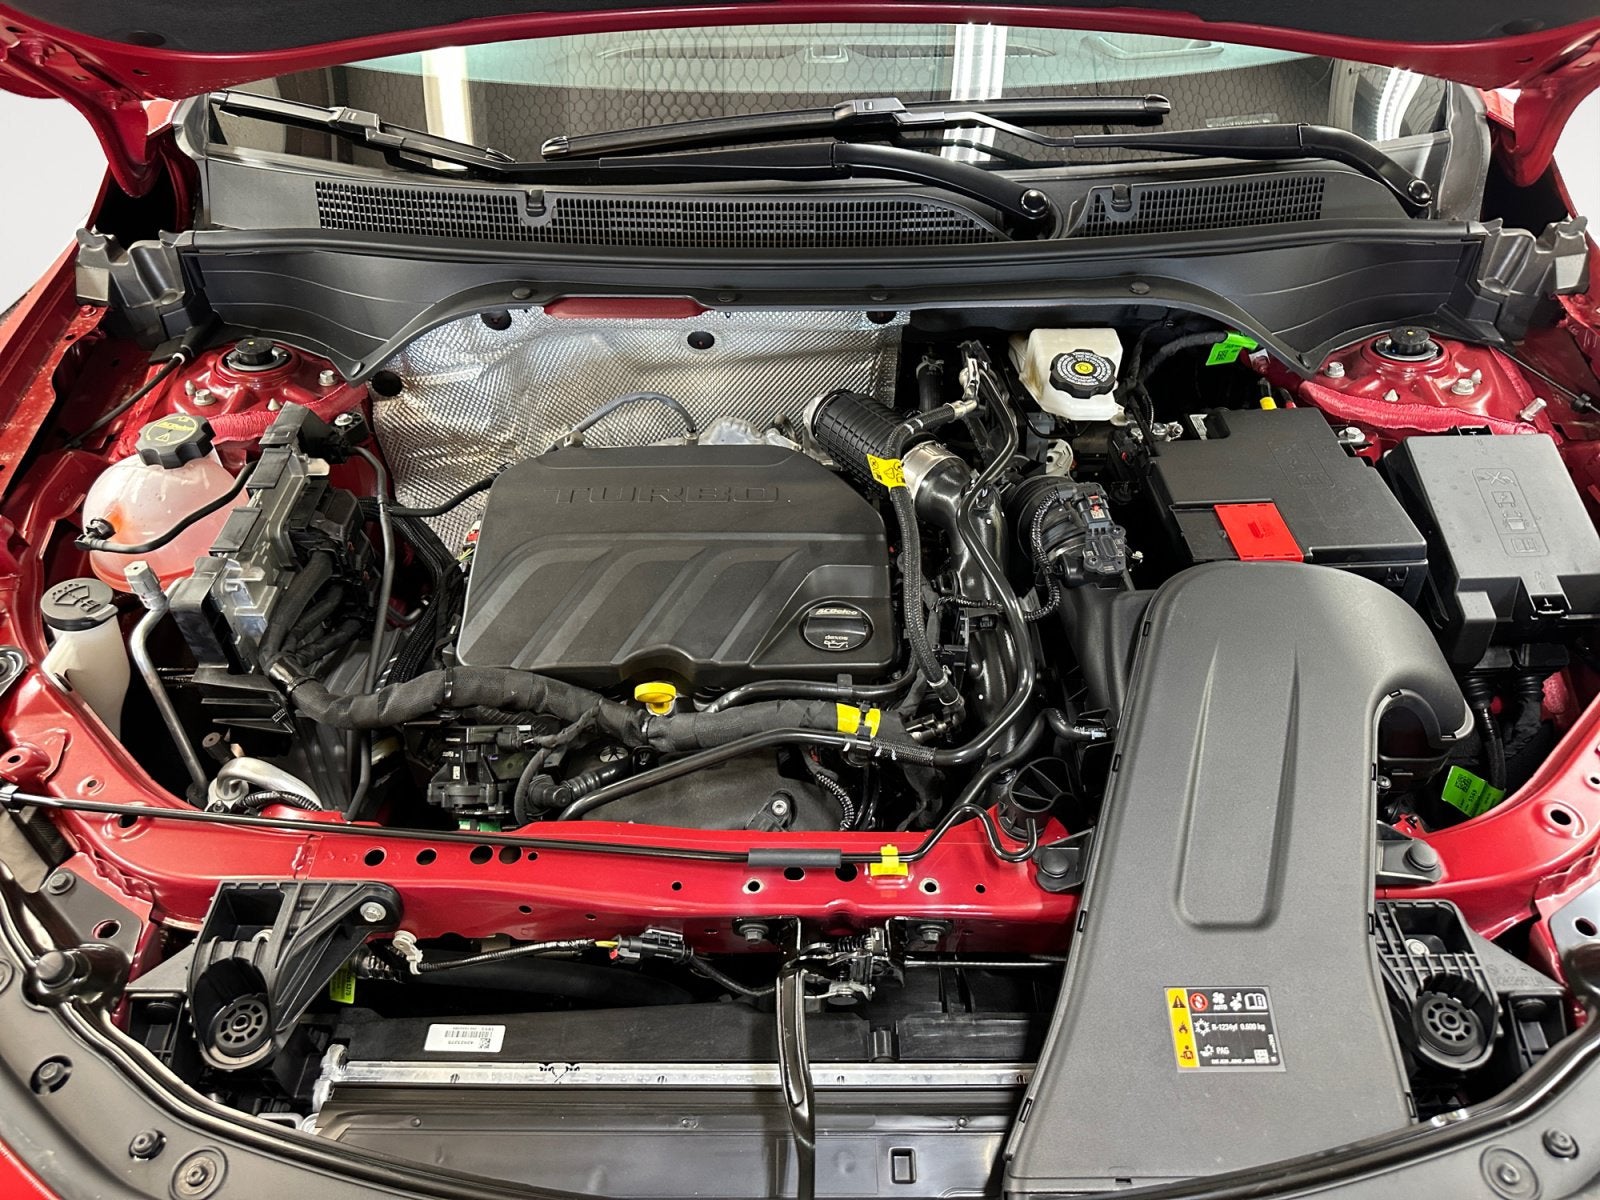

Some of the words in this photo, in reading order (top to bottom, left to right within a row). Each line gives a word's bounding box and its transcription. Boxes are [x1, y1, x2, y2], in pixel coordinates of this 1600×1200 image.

[543, 487, 779, 504] TURBO
[815, 608, 858, 616] ACDelco
[1216, 1047, 1230, 1055] PAG
